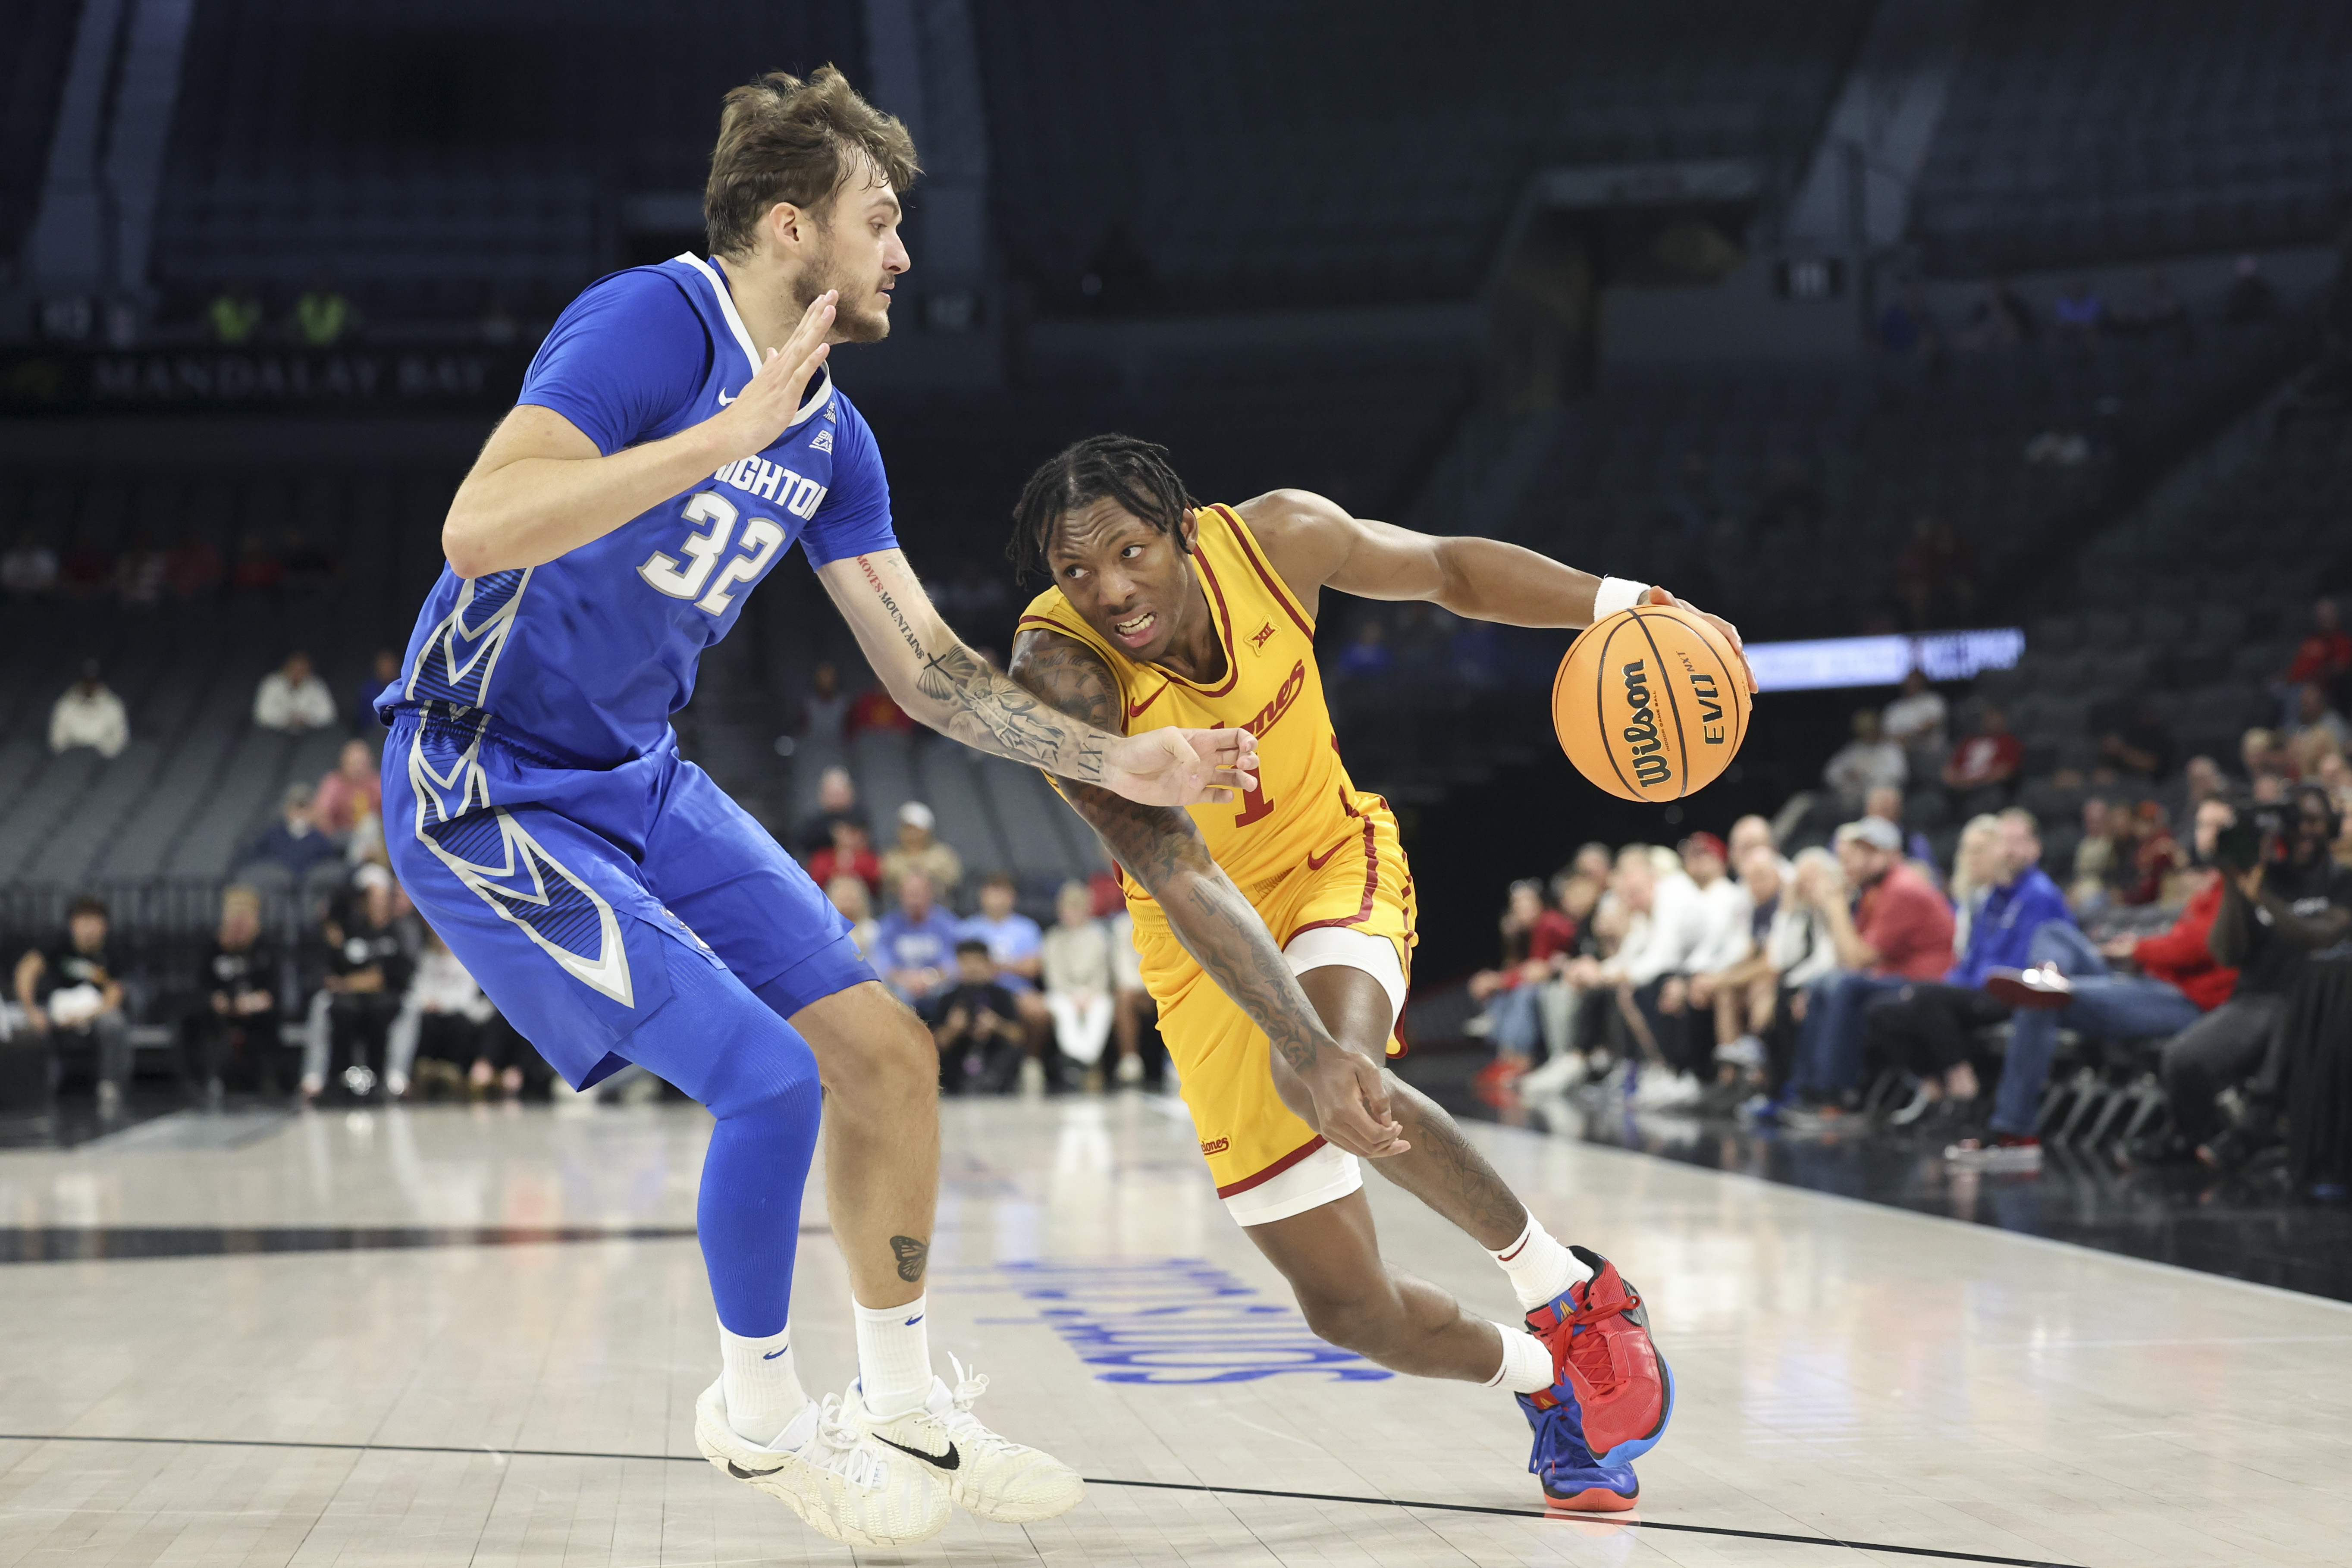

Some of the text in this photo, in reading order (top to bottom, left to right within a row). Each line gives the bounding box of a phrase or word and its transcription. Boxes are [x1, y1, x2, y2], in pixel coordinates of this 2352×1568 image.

[812, 437, 833, 453] EAS
[823, 408, 837, 425] CHAN
[714, 455, 828, 521] IGHTON
[636, 490, 786, 617] 32
[856, 554, 925, 659] MOVES MOUNTAINS
[1621, 659, 1672, 788] Wilson
[1676, 650, 1725, 745] EVO NXT
[1661, 729, 1670, 752] INDOOR
[1230, 752, 1274, 828] 1
